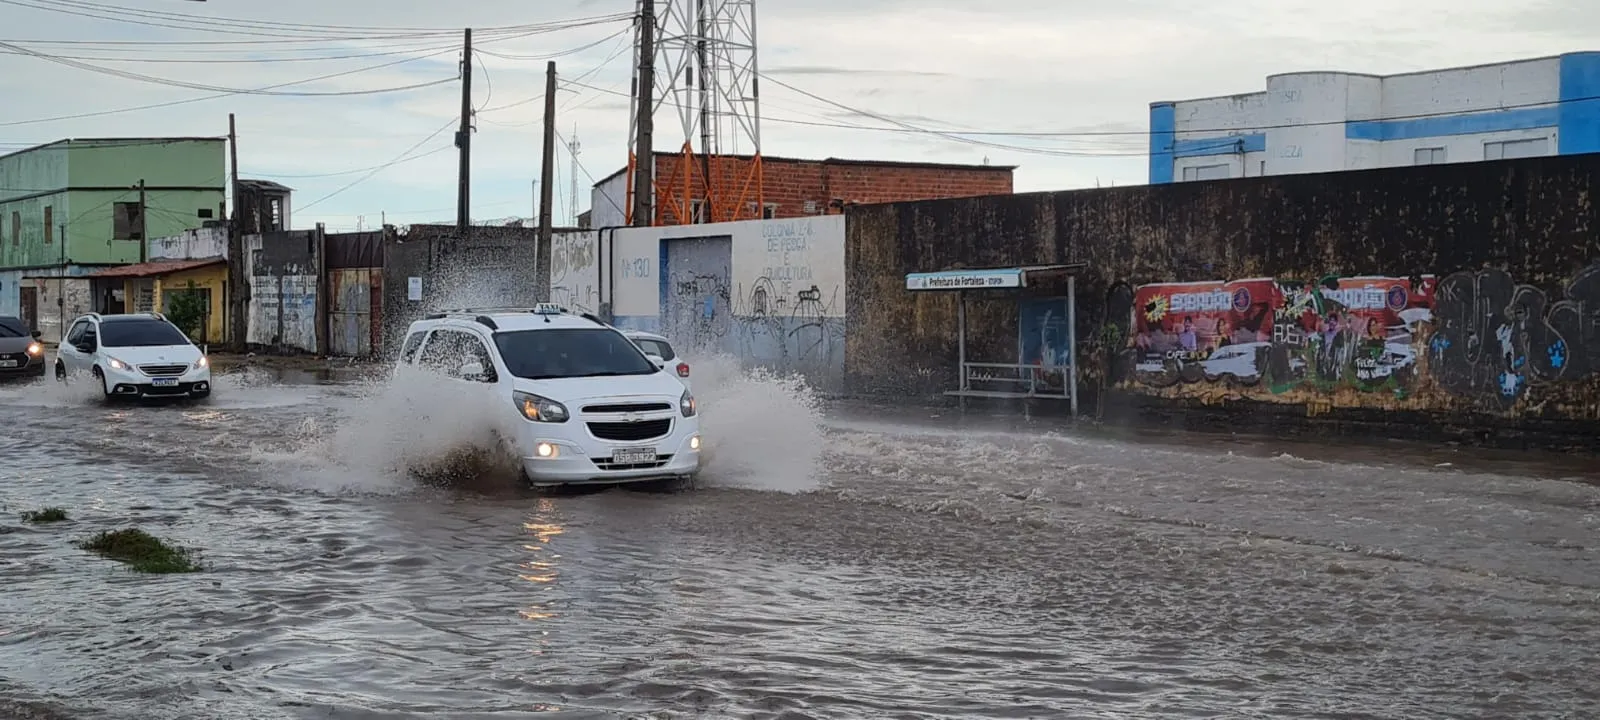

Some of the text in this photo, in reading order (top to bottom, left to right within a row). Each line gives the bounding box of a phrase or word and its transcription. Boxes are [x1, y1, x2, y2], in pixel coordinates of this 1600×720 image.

[767, 238, 778, 252] DE
[784, 252, 791, 266] E
[632, 257, 650, 278] 130
[539, 303, 559, 311] TAXI
